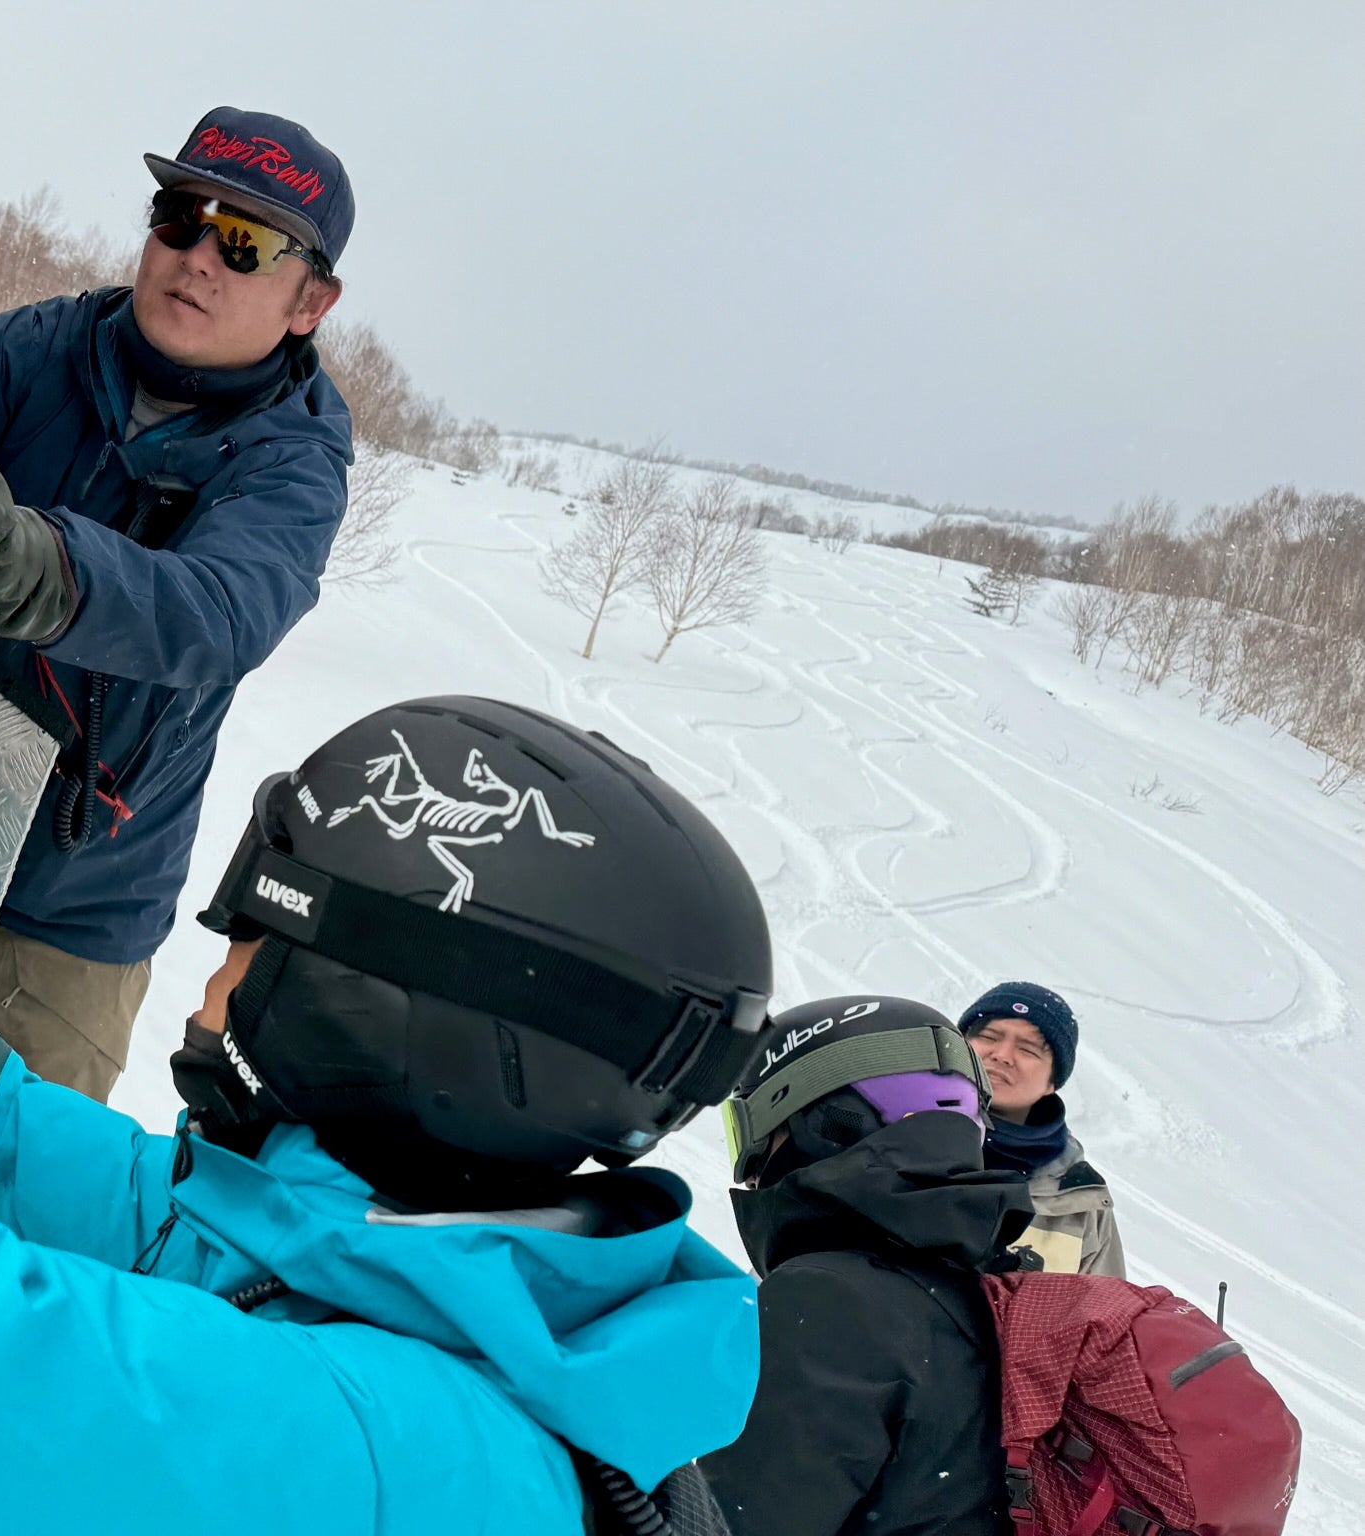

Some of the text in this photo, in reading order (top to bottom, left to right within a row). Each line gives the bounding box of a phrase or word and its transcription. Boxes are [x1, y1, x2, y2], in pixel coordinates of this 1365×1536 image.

[297, 785, 323, 824] uvex
[256, 874, 313, 917] uvex
[222, 1030, 263, 1095] uvex
[759, 1017, 834, 1077] Julbo
